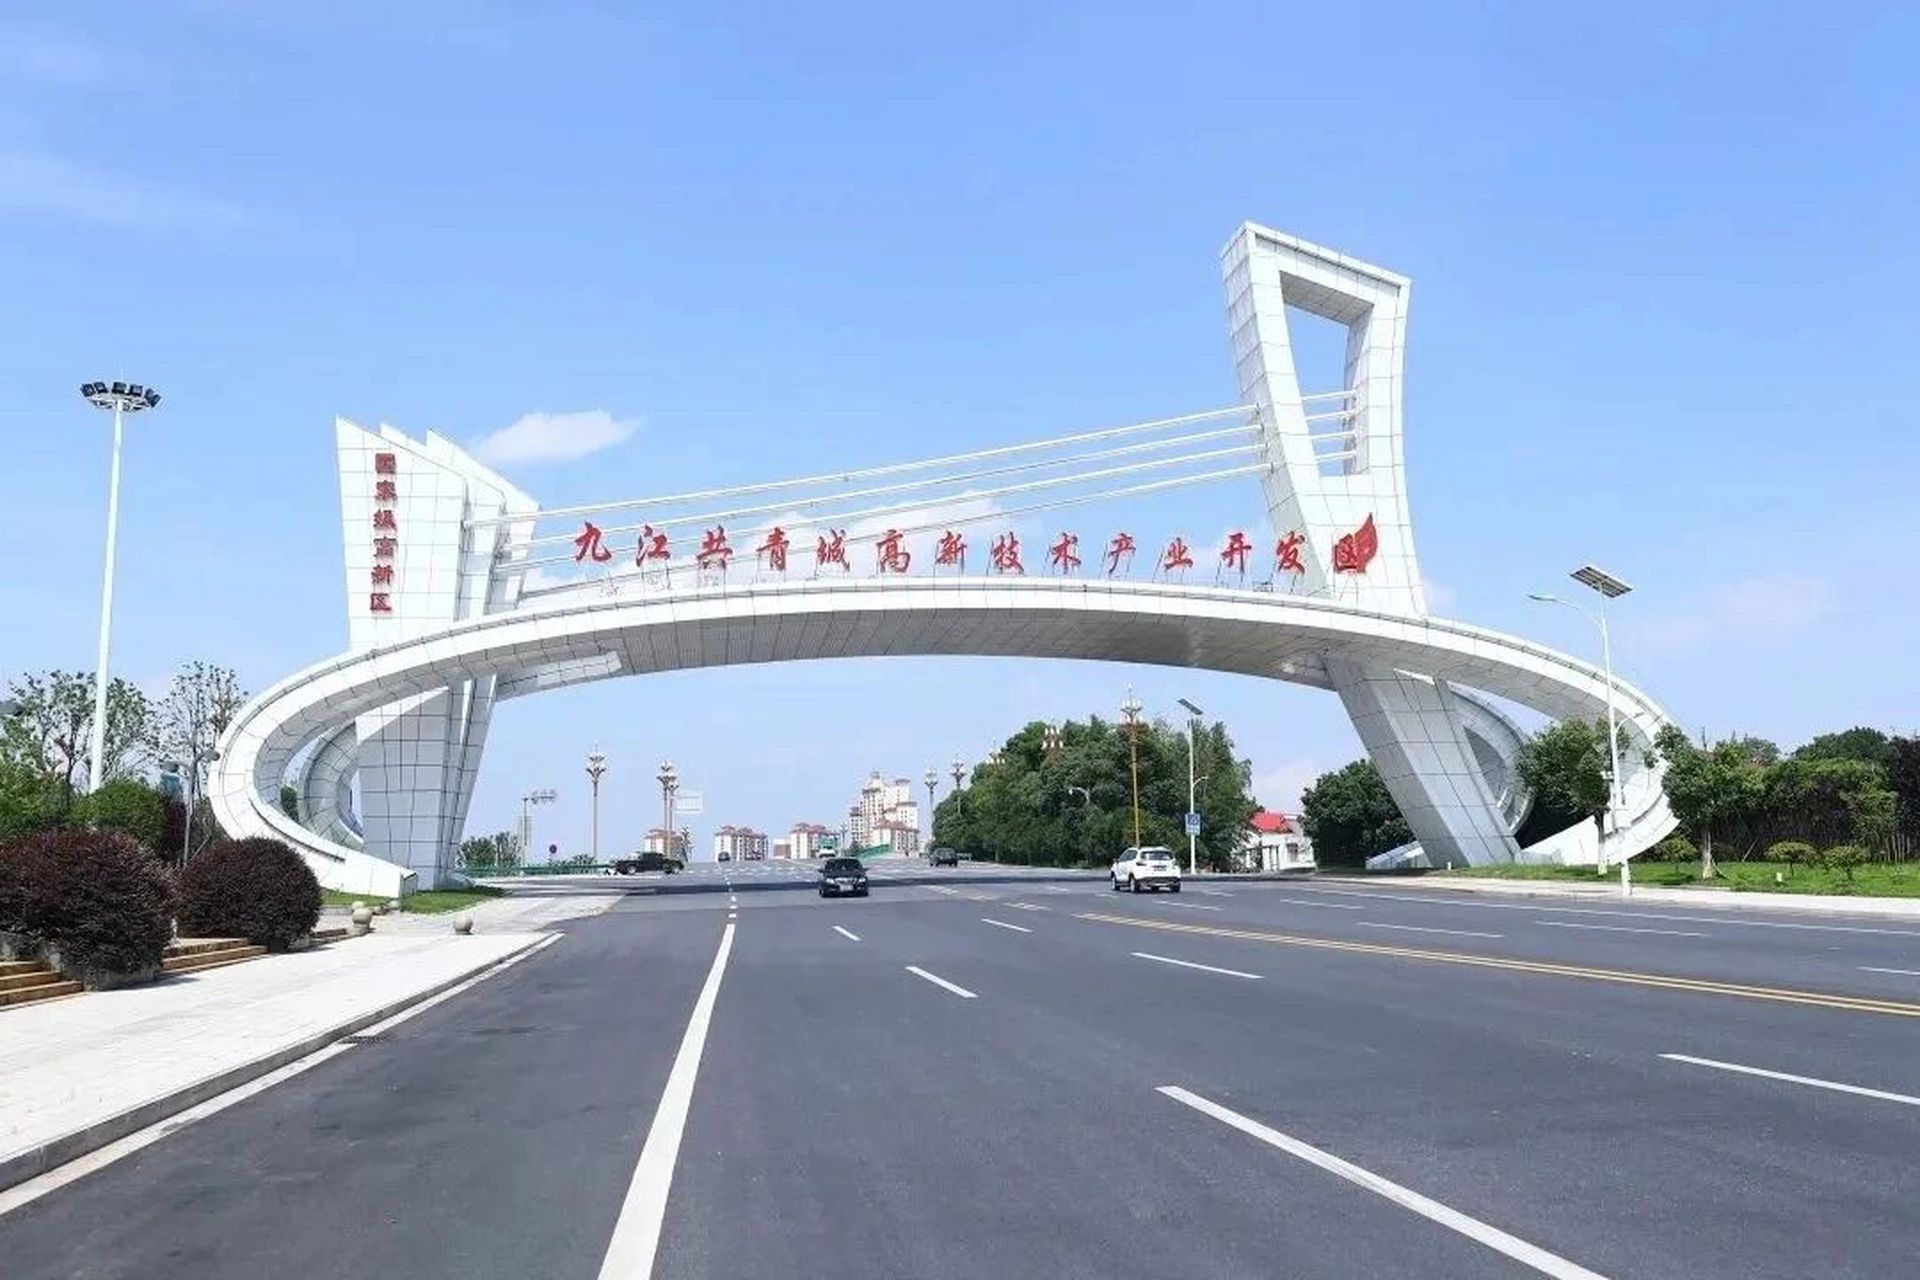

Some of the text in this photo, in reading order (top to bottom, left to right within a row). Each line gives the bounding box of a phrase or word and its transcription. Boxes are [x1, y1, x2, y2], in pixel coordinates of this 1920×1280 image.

[574, 518, 1379, 575] 九江共青城高新技术产业开发区
